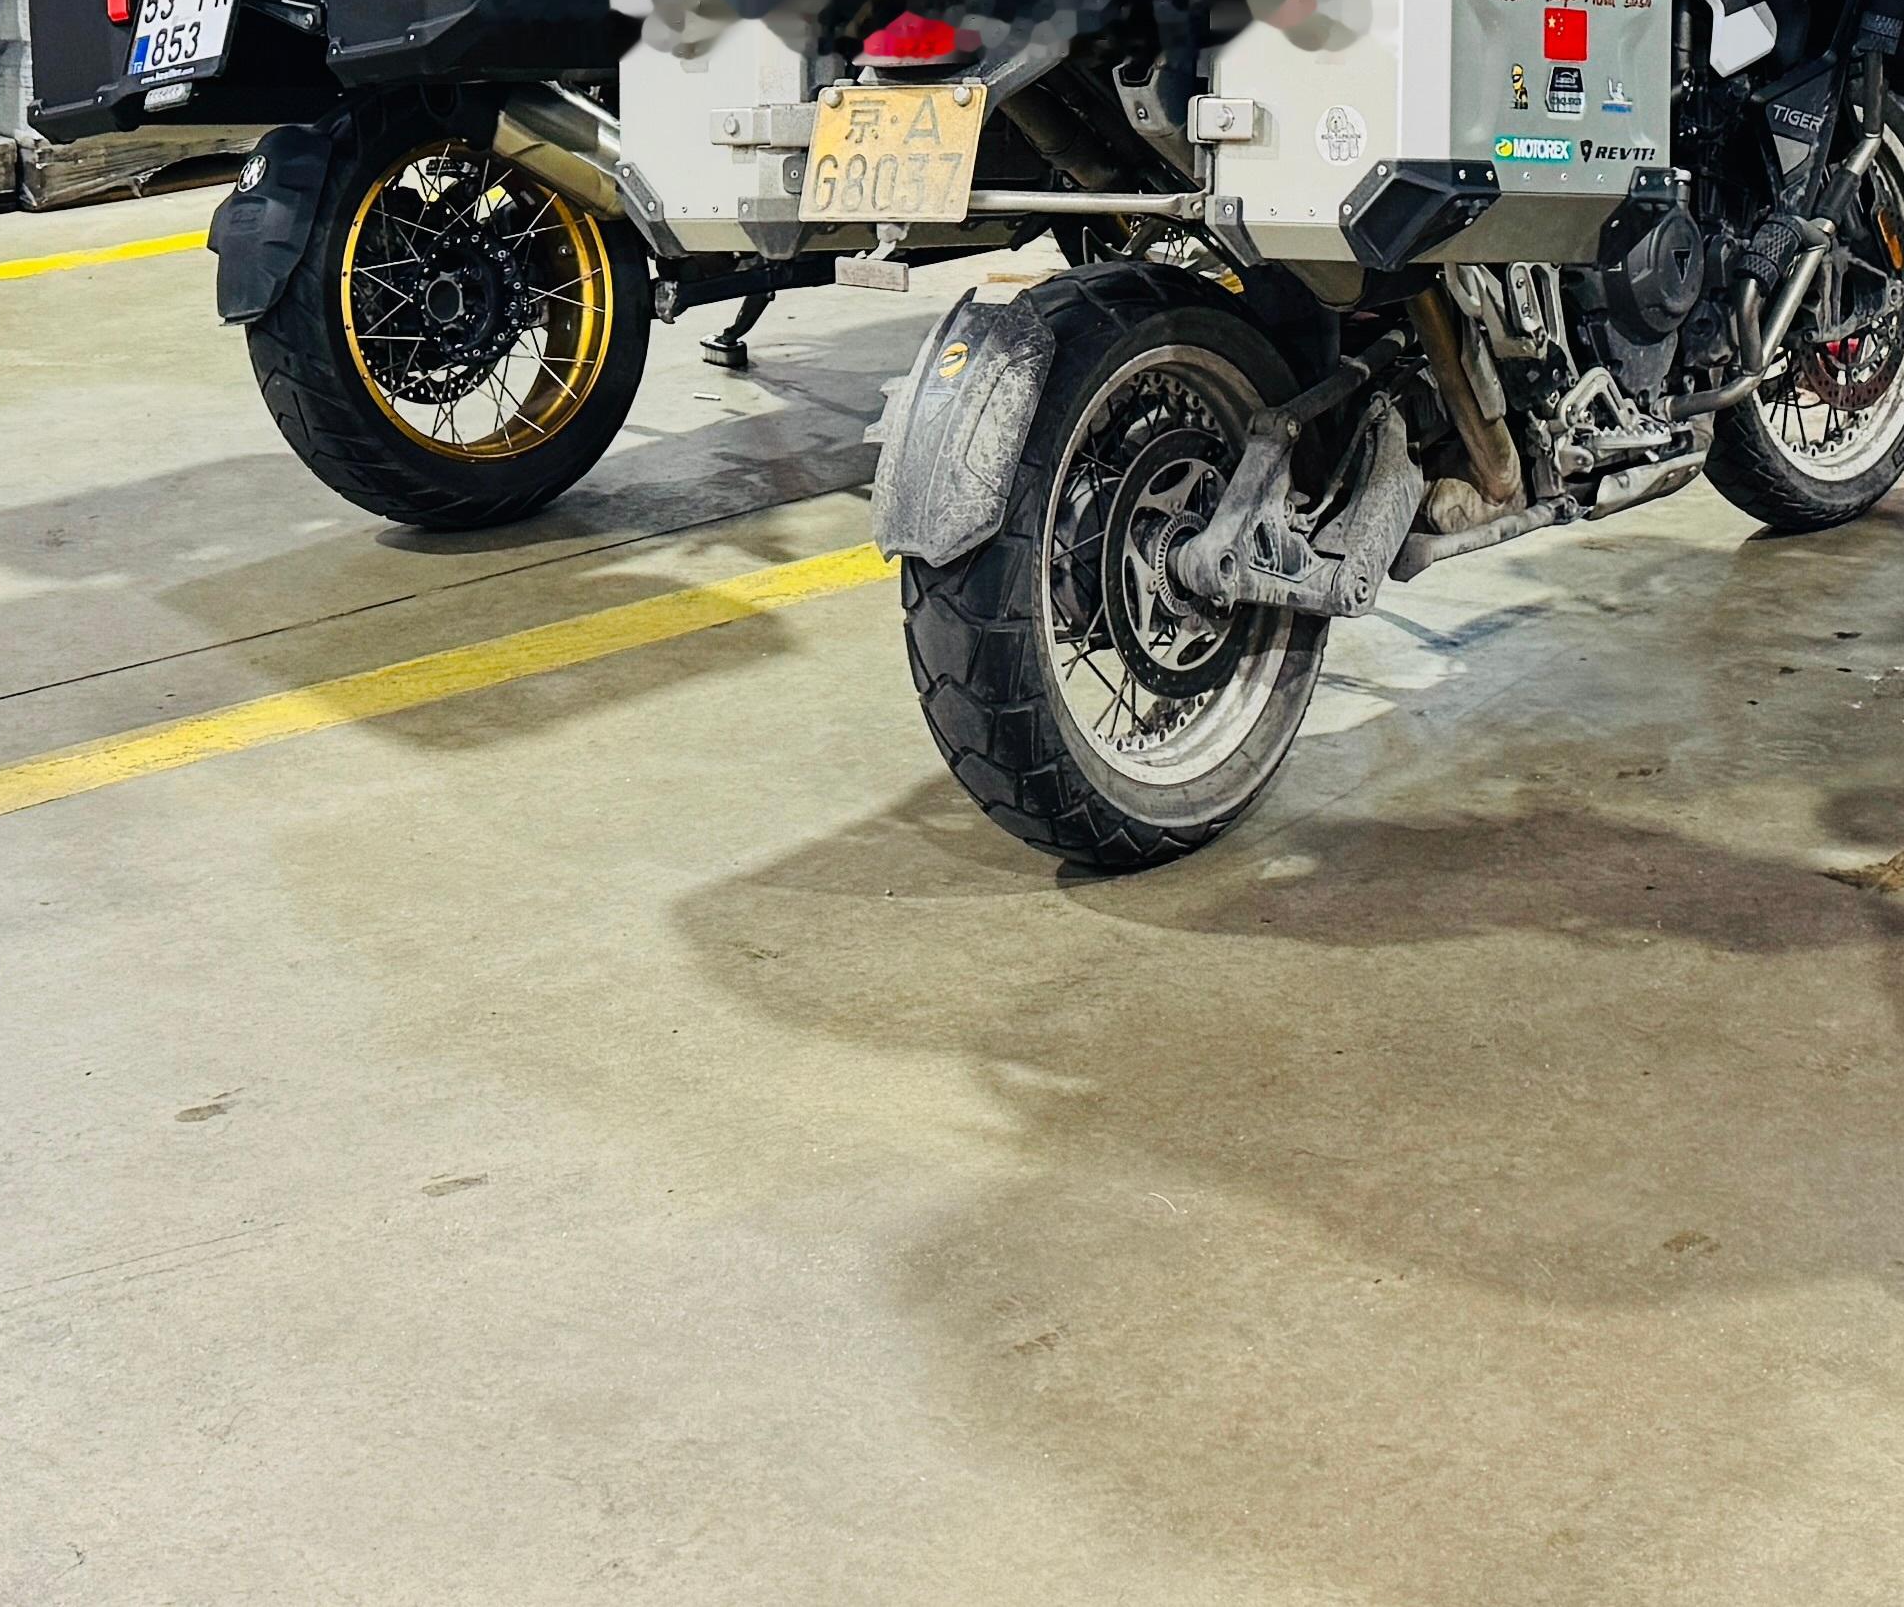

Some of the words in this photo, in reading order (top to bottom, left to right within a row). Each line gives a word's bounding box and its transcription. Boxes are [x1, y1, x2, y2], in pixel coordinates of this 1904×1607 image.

[151, 21, 201, 67] 853
[1773, 104, 1826, 133] TIGER
[1513, 138, 1571, 160] MOTOREX
